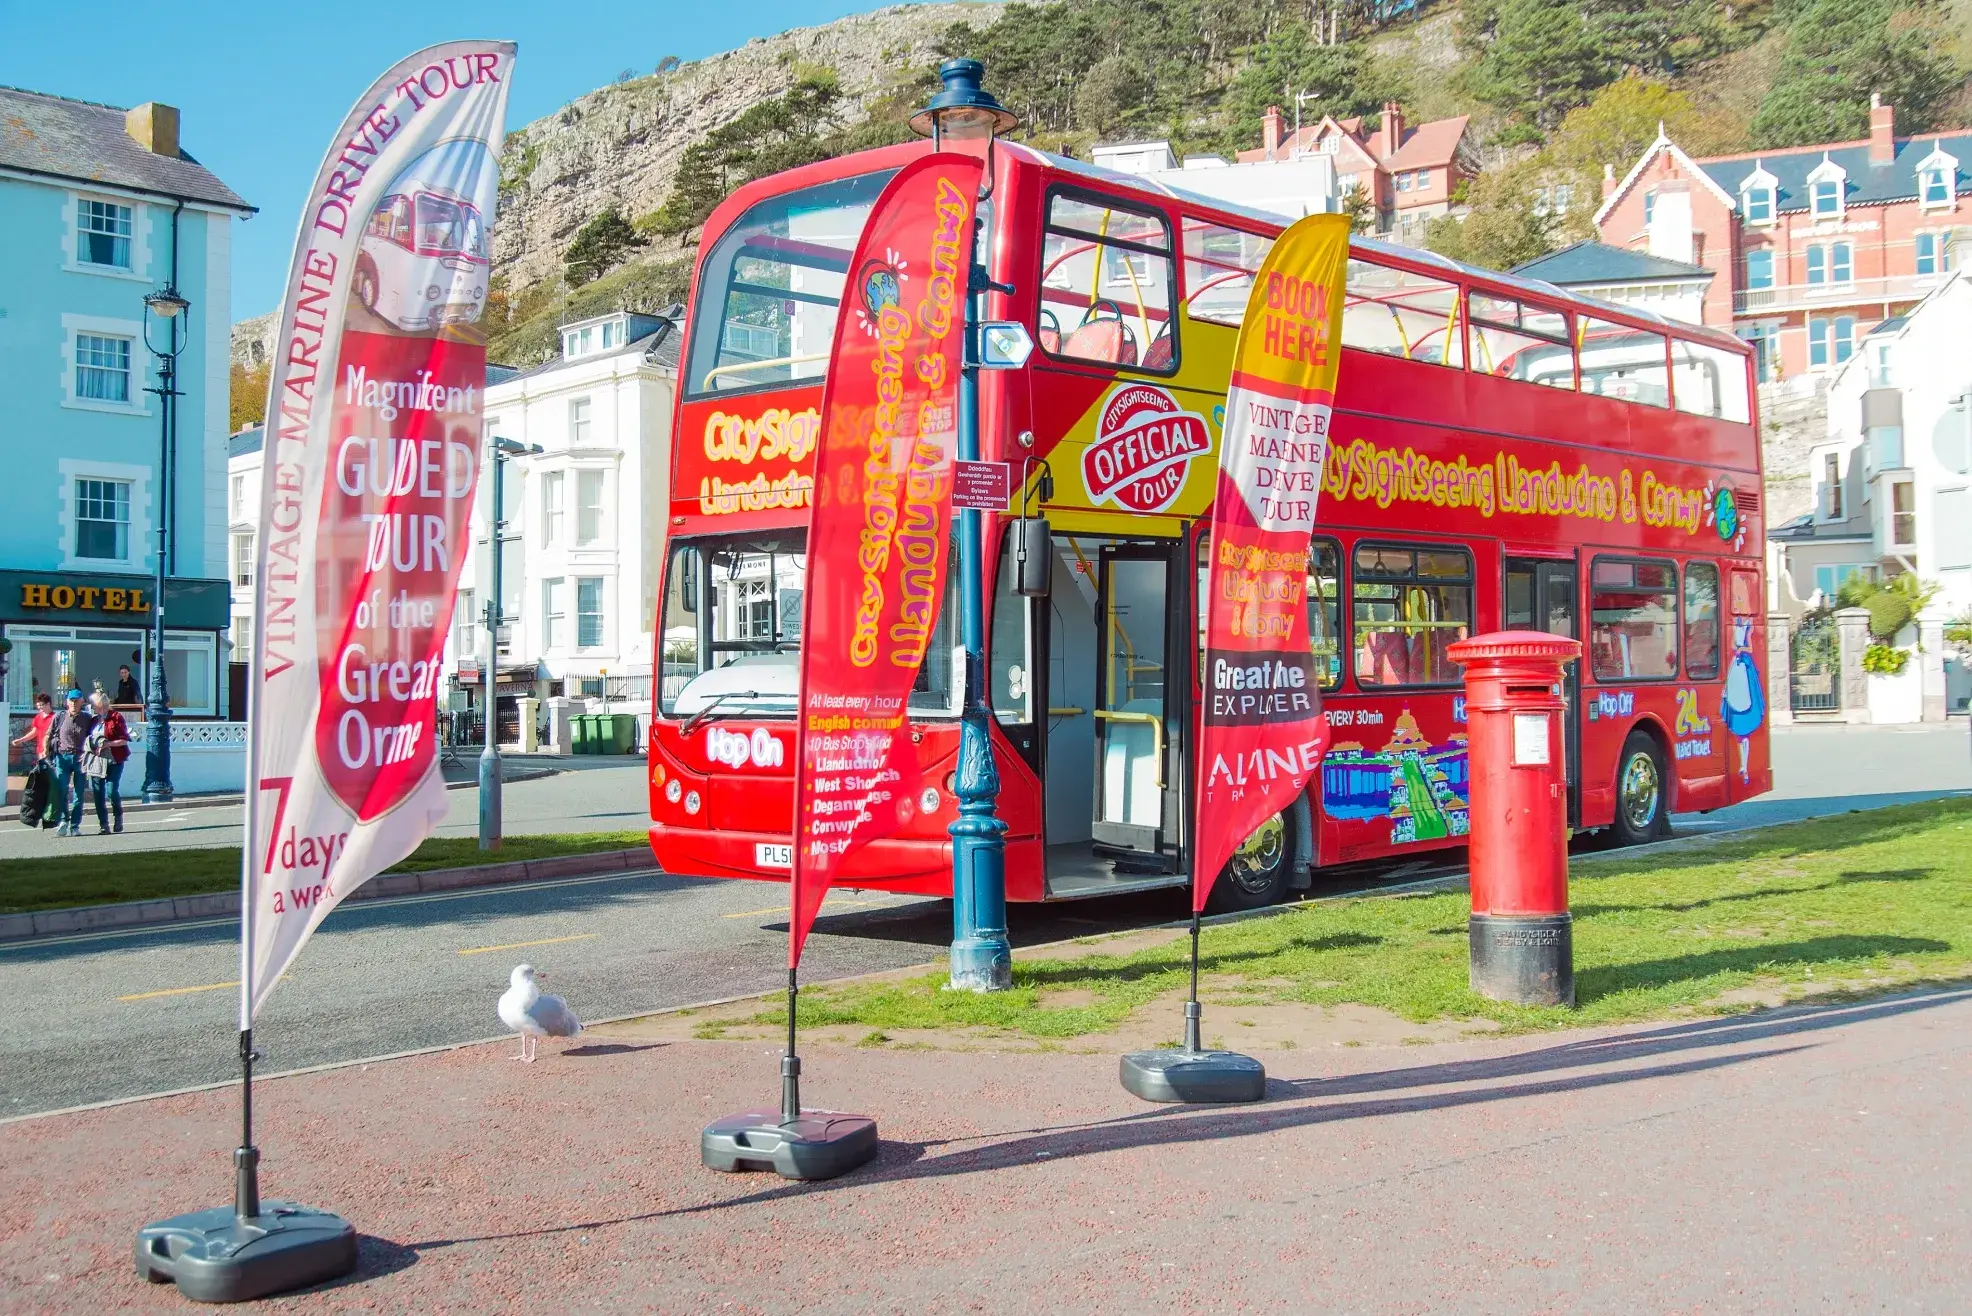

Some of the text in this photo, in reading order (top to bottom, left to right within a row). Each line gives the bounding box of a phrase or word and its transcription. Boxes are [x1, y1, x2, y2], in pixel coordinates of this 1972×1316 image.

[917, 177, 968, 339] Conwy
[1264, 314, 1329, 367] HERE
[264, 53, 501, 683] VINTAGE MARINE DRIVE TOUR
[915, 353, 946, 390] &
[1106, 390, 1169, 431] CITYSIGHTSEEING
[1249, 402, 1326, 436] VINTGE
[1094, 420, 1200, 483] OFFICIAL
[1132, 466, 1180, 504] TOUR
[1321, 436, 1702, 536] tySightseeing Llandudno & Conwy
[21, 584, 150, 613] HOTEL
[356, 589, 434, 630] of the
[338, 644, 440, 704] Great
[1214, 658, 1272, 691] Great
[809, 693, 902, 711] At least every hour
[1323, 710, 1354, 727] EVERY
[1599, 690, 1634, 718] Hop Off
[337, 709, 424, 770] Orme
[808, 714, 850, 733] English
[706, 726, 784, 769] Hop On
[809, 736, 821, 751] 10
[823, 735, 840, 751] Bus
[814, 778, 841, 793] West
[259, 777, 348, 880] 7 days
[273, 891, 285, 914] a
